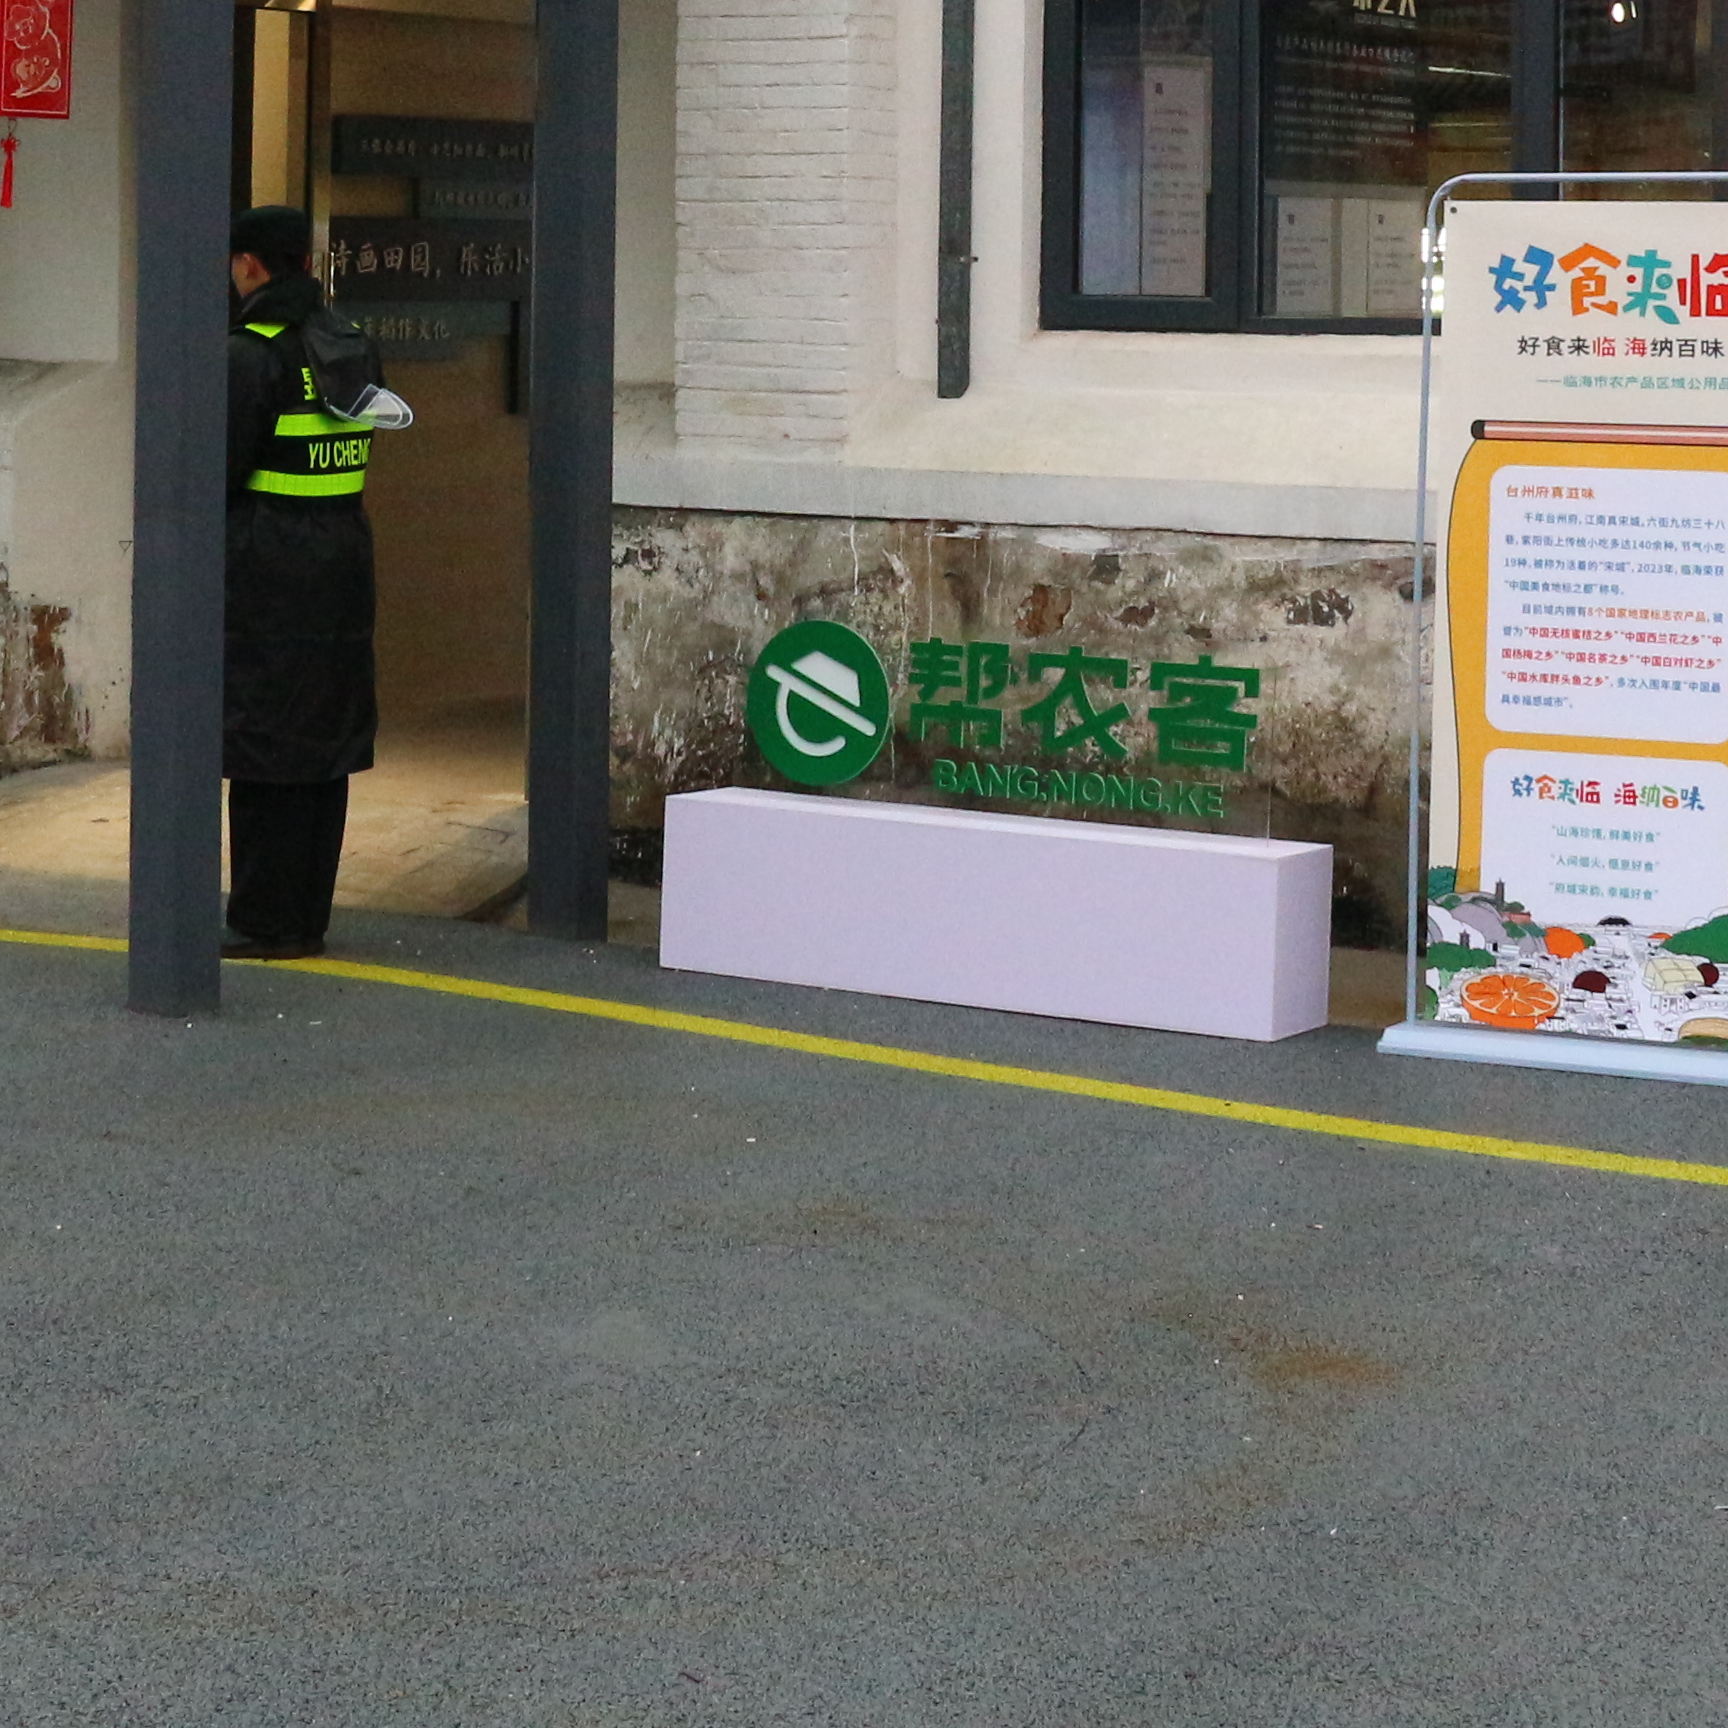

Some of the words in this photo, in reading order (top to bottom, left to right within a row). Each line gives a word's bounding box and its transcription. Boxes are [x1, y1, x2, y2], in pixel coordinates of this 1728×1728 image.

[1517, 336, 1616, 358] 好食来临
[1624, 337, 1725, 359] 海纳百味
[308, 441, 331, 470] YU
[907, 636, 1261, 773] 帮农客
[1510, 773, 1601, 806] 好食来临
[1614, 781, 1705, 811] 海纳百味
